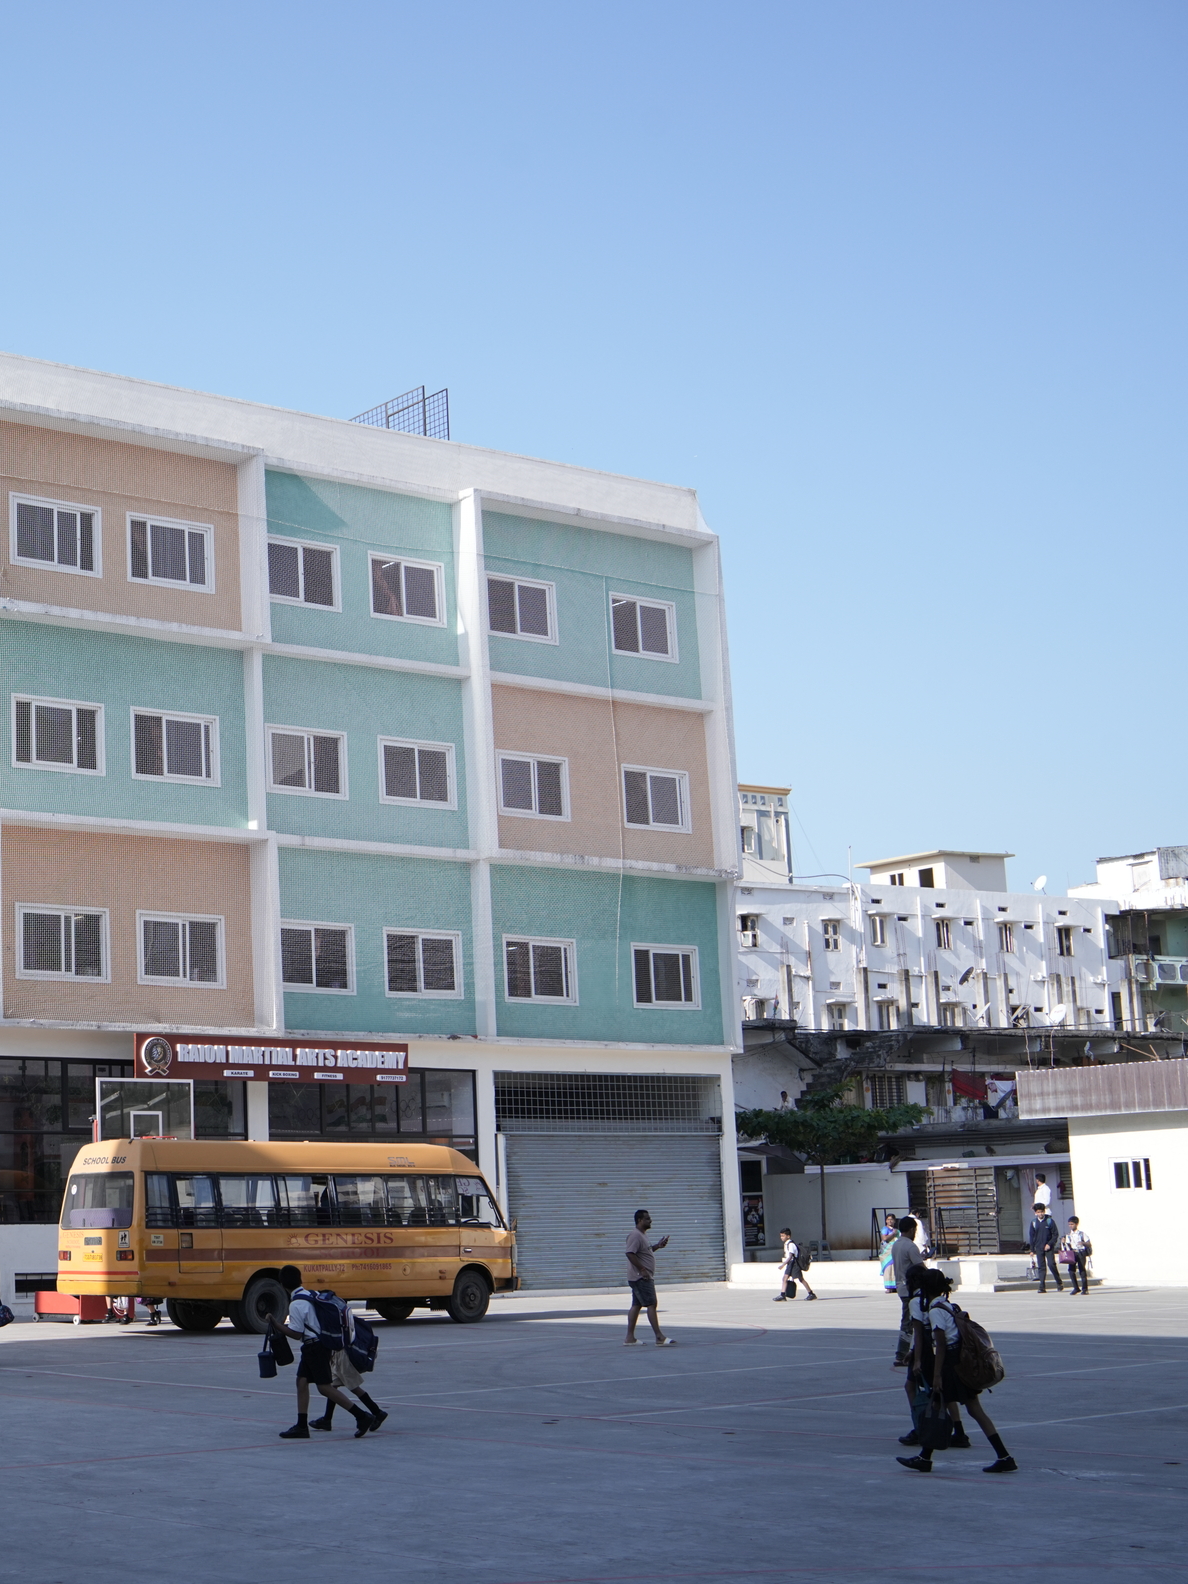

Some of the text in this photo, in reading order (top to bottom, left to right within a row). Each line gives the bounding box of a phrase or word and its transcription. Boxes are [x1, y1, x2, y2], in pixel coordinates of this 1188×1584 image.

[176, 1043, 227, 1063] RAION
[227, 1045, 295, 1066] MARTIAL
[295, 1047, 336, 1067] ARTS
[336, 1049, 407, 1070] ACADEMY
[82, 1156, 127, 1166] SCHOOL BUS
[387, 1156, 415, 1164] SML
[62, 1231, 85, 1239] GENESIS
[304, 1232, 394, 1246] GENESIS
[320, 1248, 385, 1258] SCHOOL
[303, 1264, 346, 1273] KUKATPALLY-72
